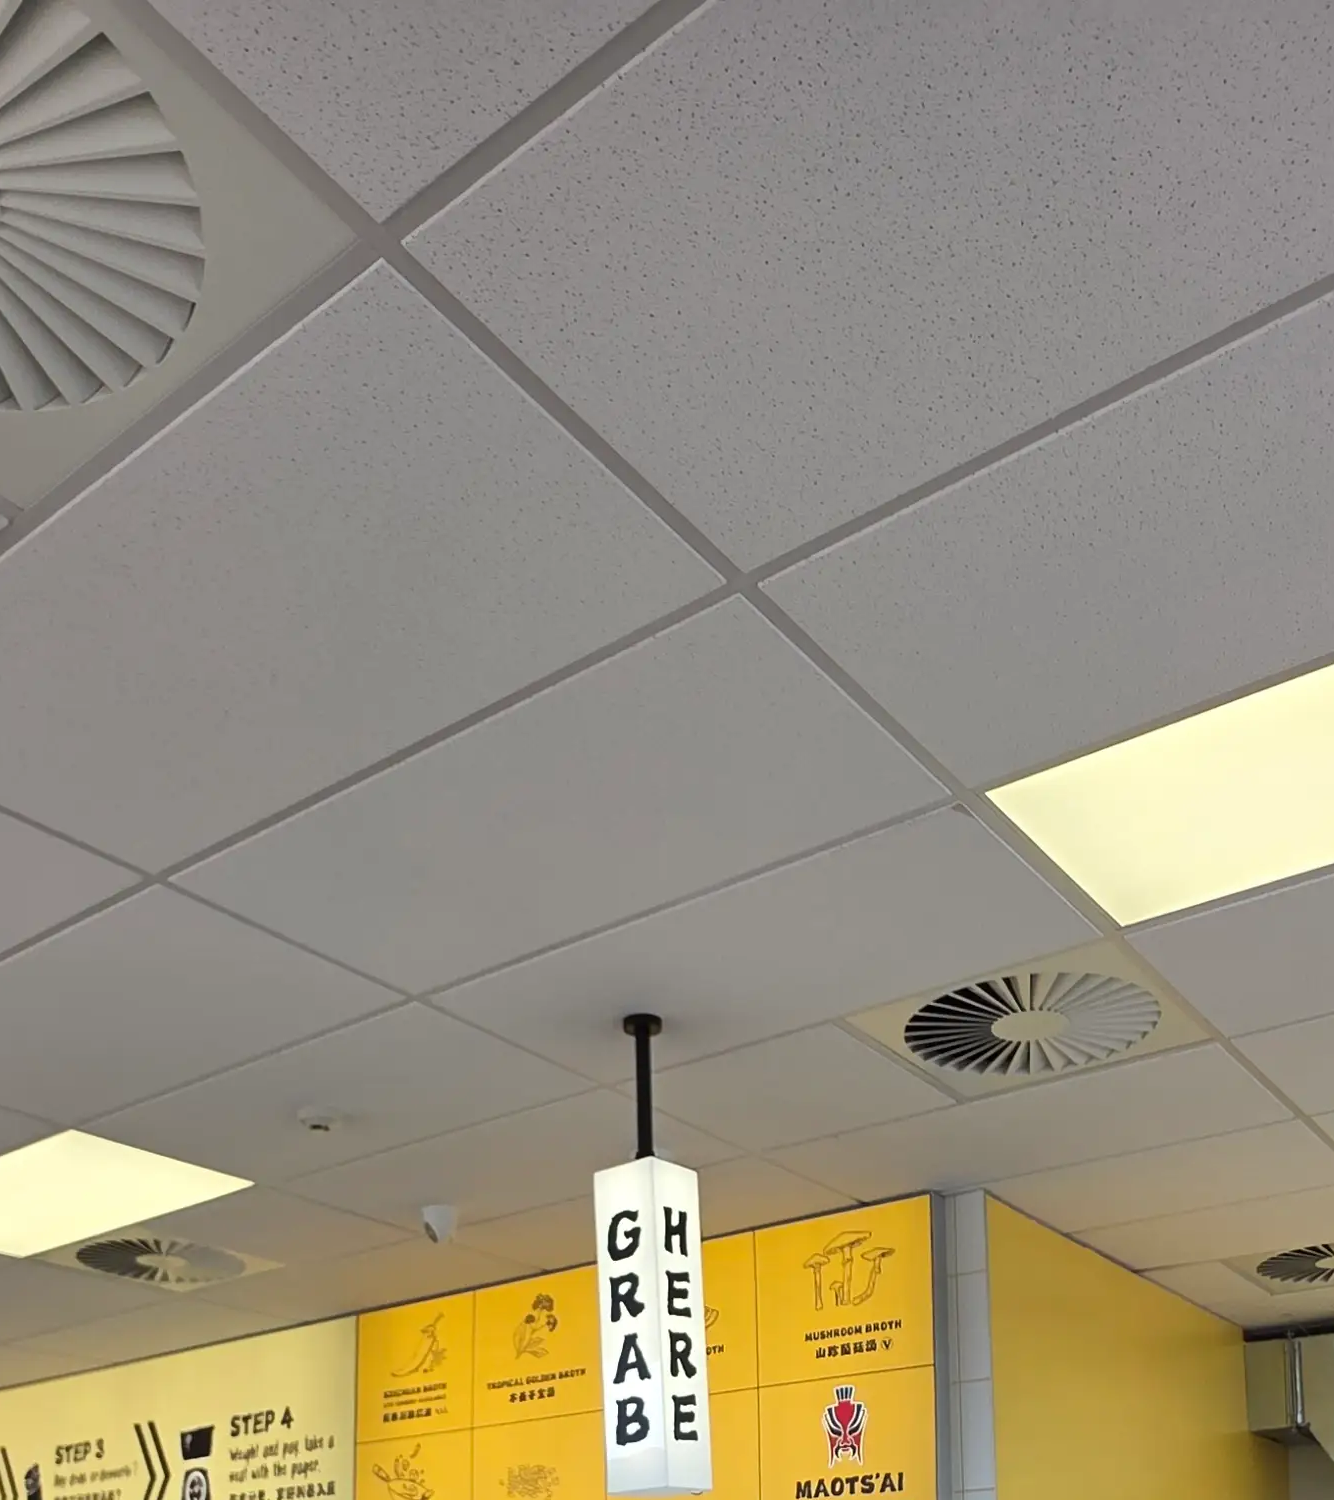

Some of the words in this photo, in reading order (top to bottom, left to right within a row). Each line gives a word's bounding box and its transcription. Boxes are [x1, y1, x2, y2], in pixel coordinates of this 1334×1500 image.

[608, 1210, 651, 1446] GRAB
[663, 1206, 698, 1442] HERE
[804, 1323, 863, 1342] MUSHROOM
[865, 1319, 902, 1333] BROTH
[706, 1345, 724, 1355] OTH
[558, 1368, 586, 1379] BROTH
[231, 1409, 275, 1437] STEP
[281, 1405, 294, 1429] 4
[55, 1441, 91, 1465] STEP
[95, 1437, 105, 1459] 3
[796, 1471, 904, 1499] MAOTS'AI
